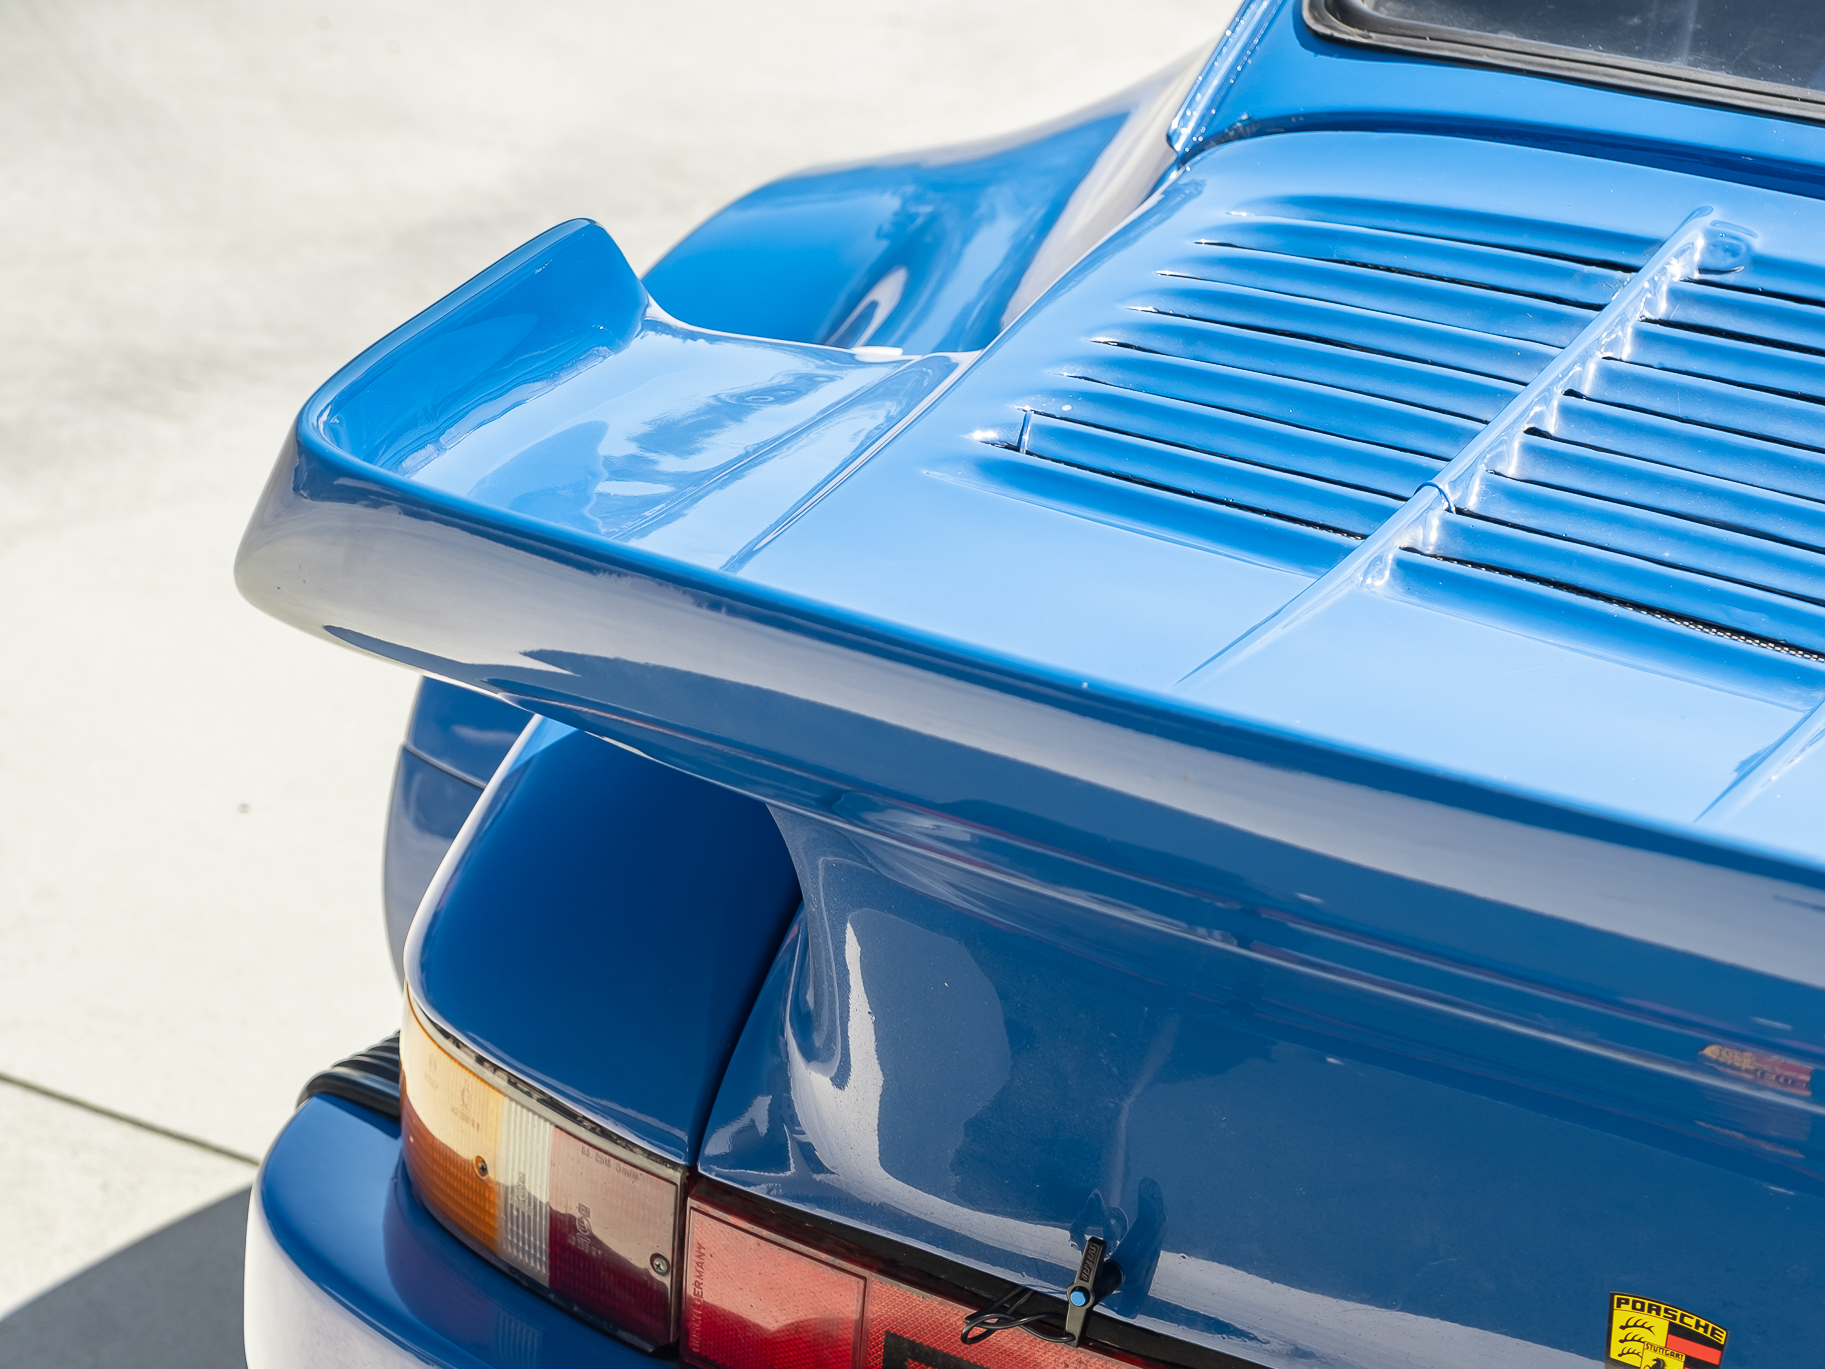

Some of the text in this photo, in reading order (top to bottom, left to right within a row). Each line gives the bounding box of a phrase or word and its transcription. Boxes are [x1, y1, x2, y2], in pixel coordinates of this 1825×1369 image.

[692, 1242, 706, 1306] GERMANY
[1616, 1297, 1725, 1343] PORSCHE
[1645, 1344, 1685, 1361] STUTTGART
